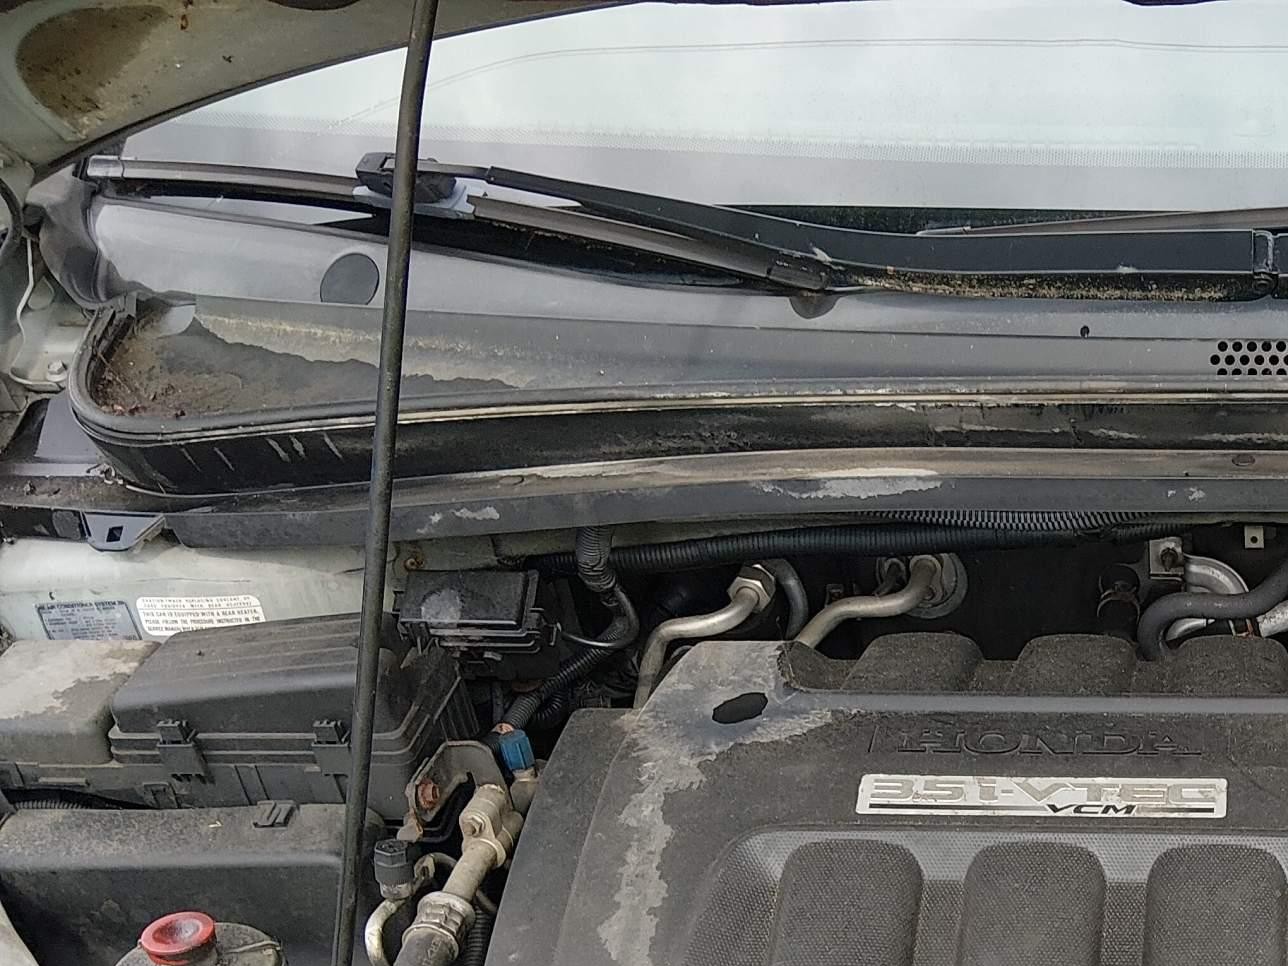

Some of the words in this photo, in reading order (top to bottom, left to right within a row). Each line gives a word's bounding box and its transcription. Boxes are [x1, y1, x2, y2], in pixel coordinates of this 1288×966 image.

[896, 731, 1202, 755] HONDA
[871, 778, 966, 802] 3.5
[976, 777, 1217, 804] i-VTEC
[1046, 804, 1137, 815] VCM
